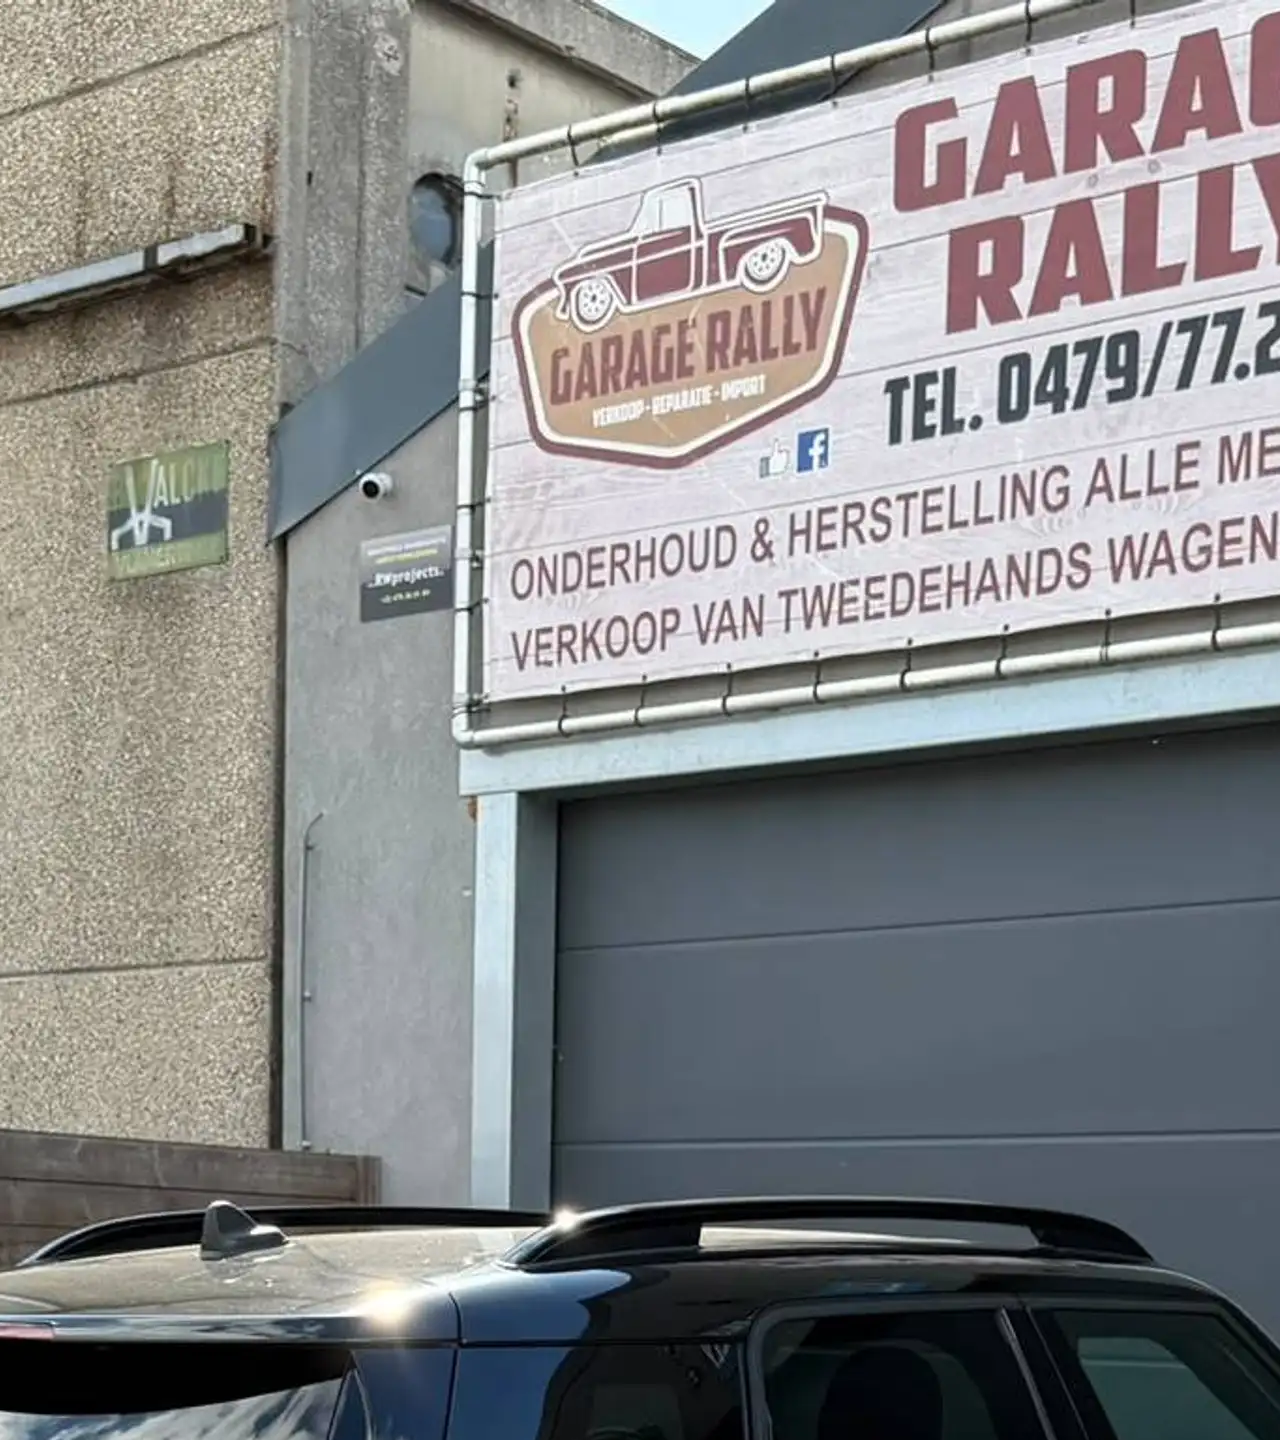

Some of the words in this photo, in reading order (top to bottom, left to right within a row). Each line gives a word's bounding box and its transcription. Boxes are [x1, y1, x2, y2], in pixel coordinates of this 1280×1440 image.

[549, 317, 696, 406] GARAGE
[706, 286, 827, 374] RALLY
[883, 365, 983, 446] TEL.
[510, 523, 738, 601] ONDERHOUD
[750, 515, 775, 564] &
[787, 462, 1071, 557] HERSTELLING
[1084, 440, 1202, 508] ALLE
[510, 607, 681, 672] VERKOOP
[692, 592, 766, 646] VAN
[777, 540, 1093, 635] TWEEDEHANDS
